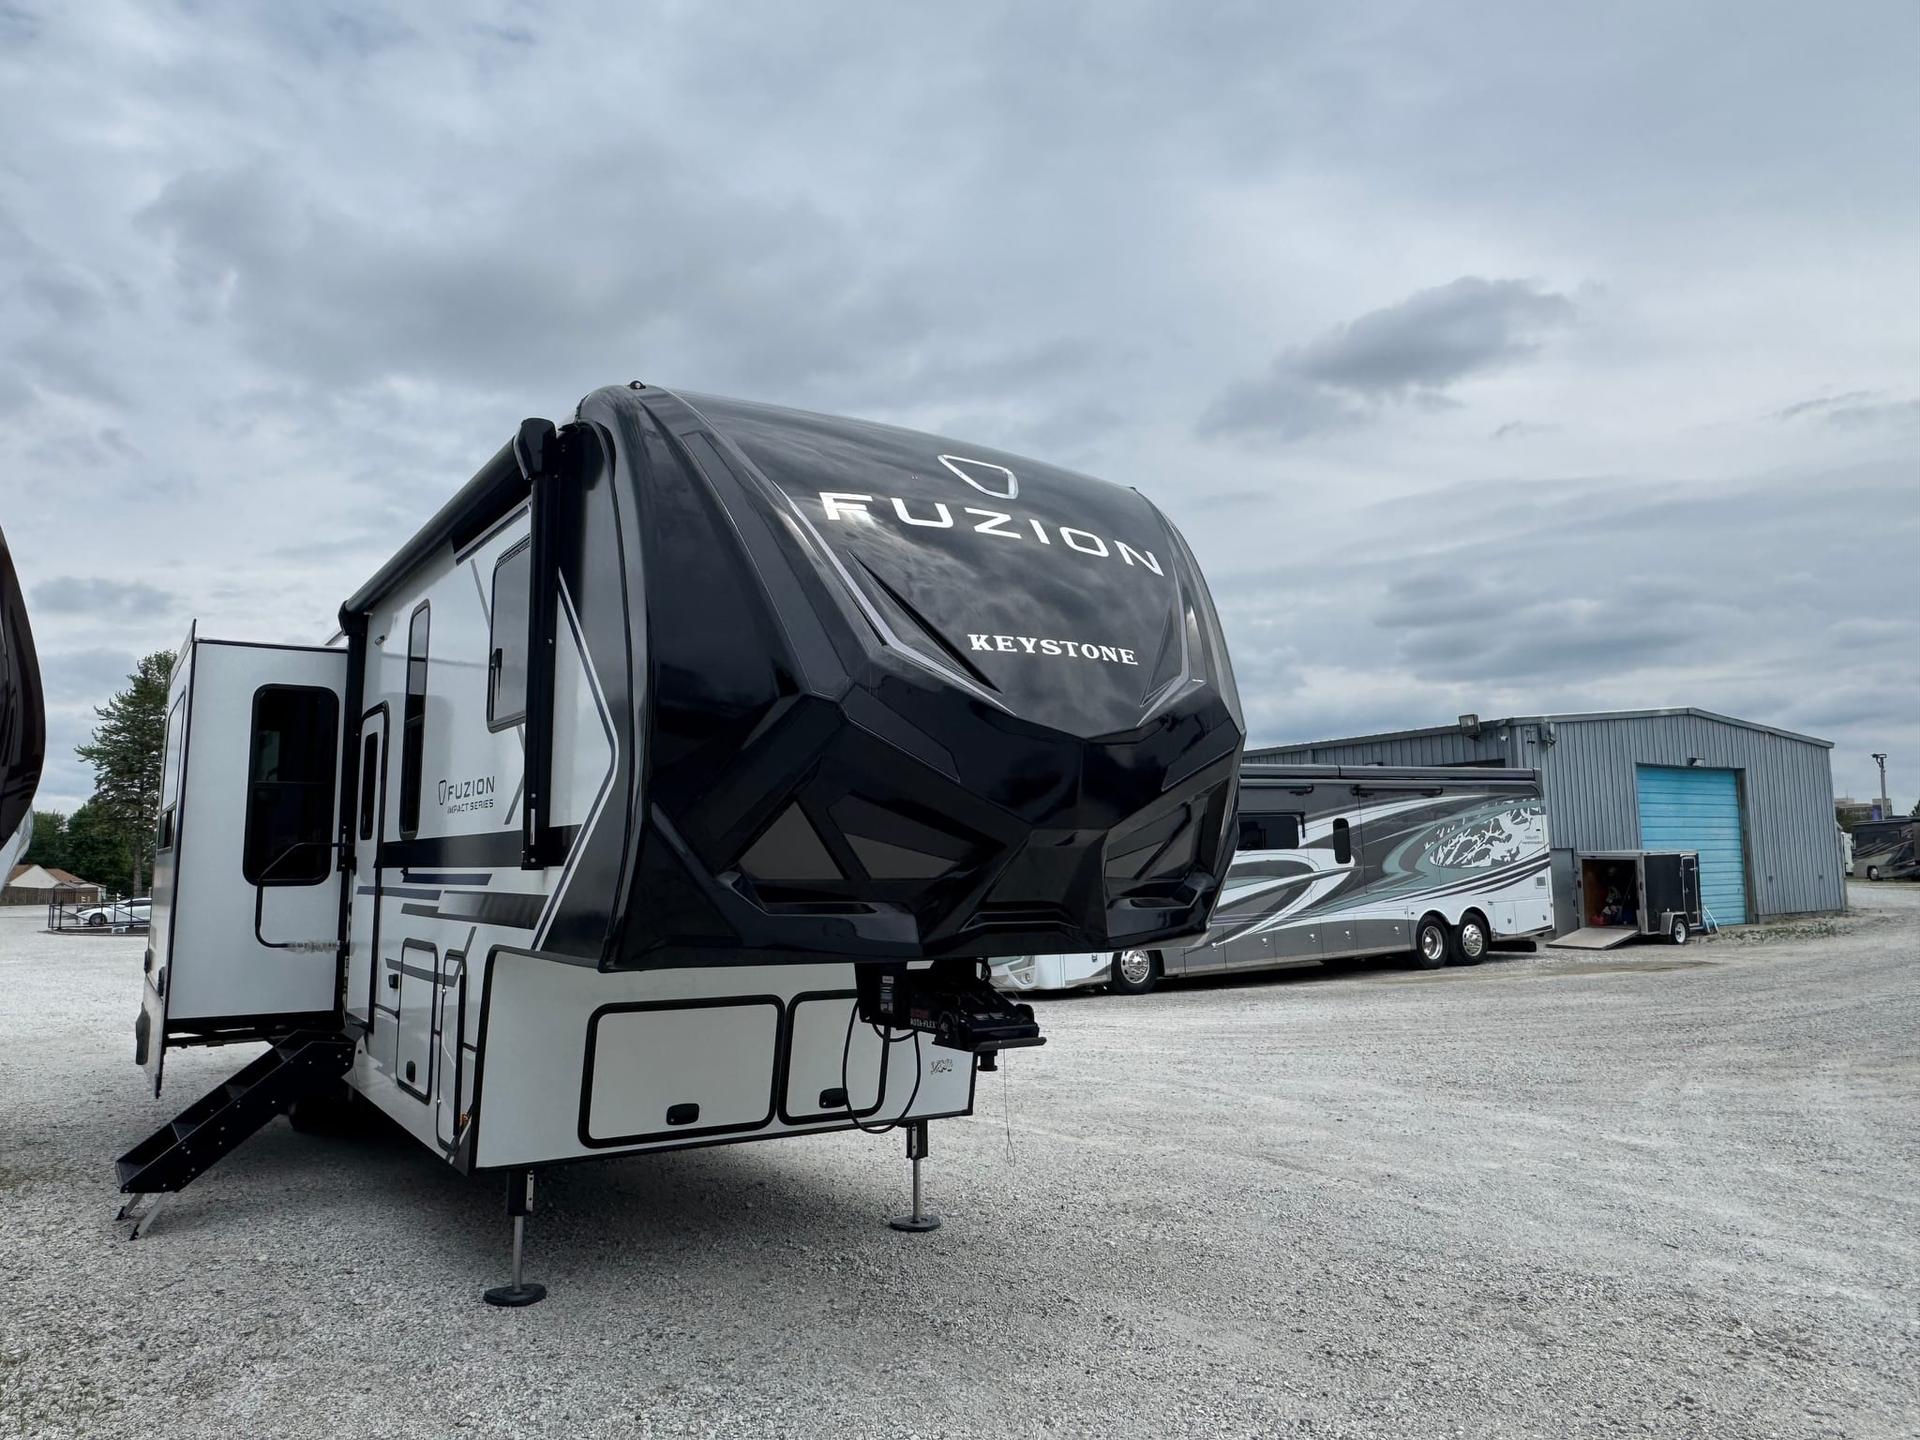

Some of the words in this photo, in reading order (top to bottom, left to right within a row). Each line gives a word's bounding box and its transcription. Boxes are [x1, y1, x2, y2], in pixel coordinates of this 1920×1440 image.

[819, 491, 1164, 577] FUZION
[967, 633, 1138, 665] KEYSTONE
[447, 776, 495, 801] FUZION
[447, 803, 469, 814] IMPACT
[469, 799, 494, 811] SERIES
